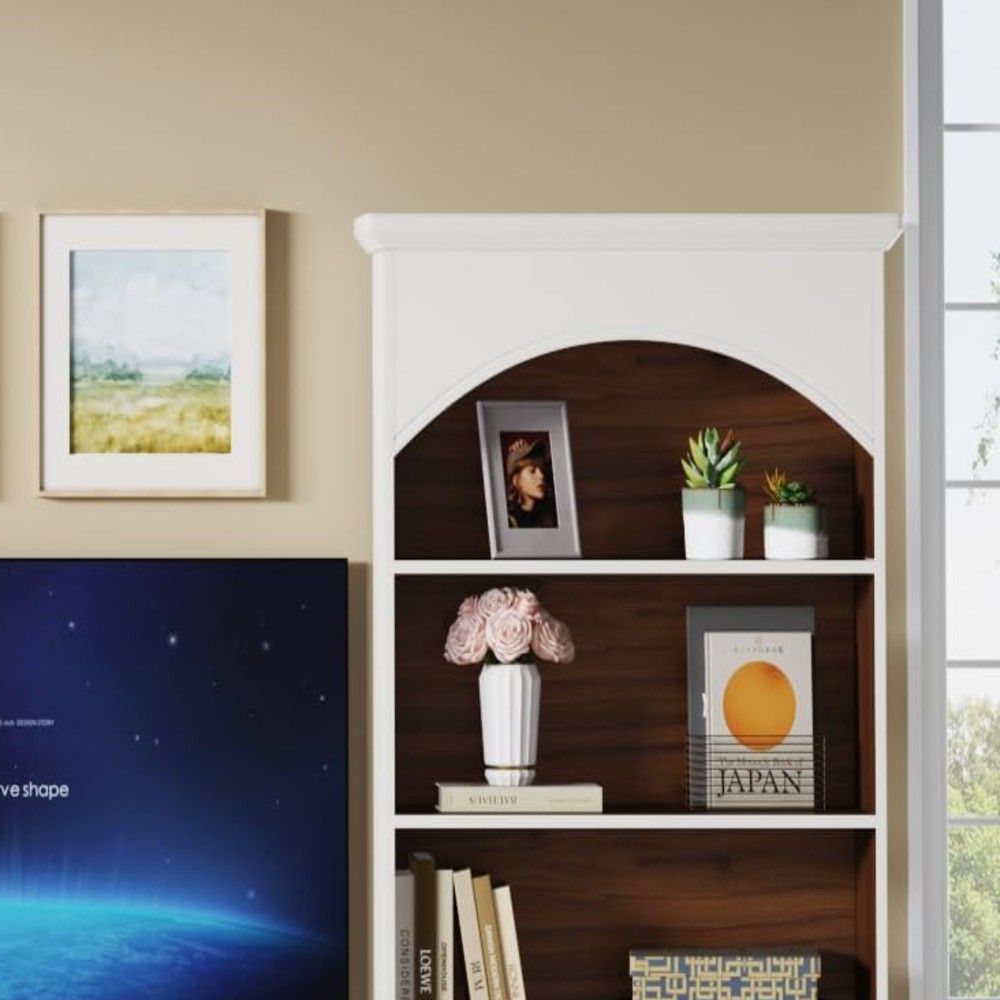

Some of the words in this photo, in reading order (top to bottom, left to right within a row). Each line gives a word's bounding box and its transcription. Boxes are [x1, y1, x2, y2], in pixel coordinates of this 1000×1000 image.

[22, 781, 70, 800] shape
[717, 767, 802, 798] JAPAN
[420, 949, 432, 994] LOEWE
